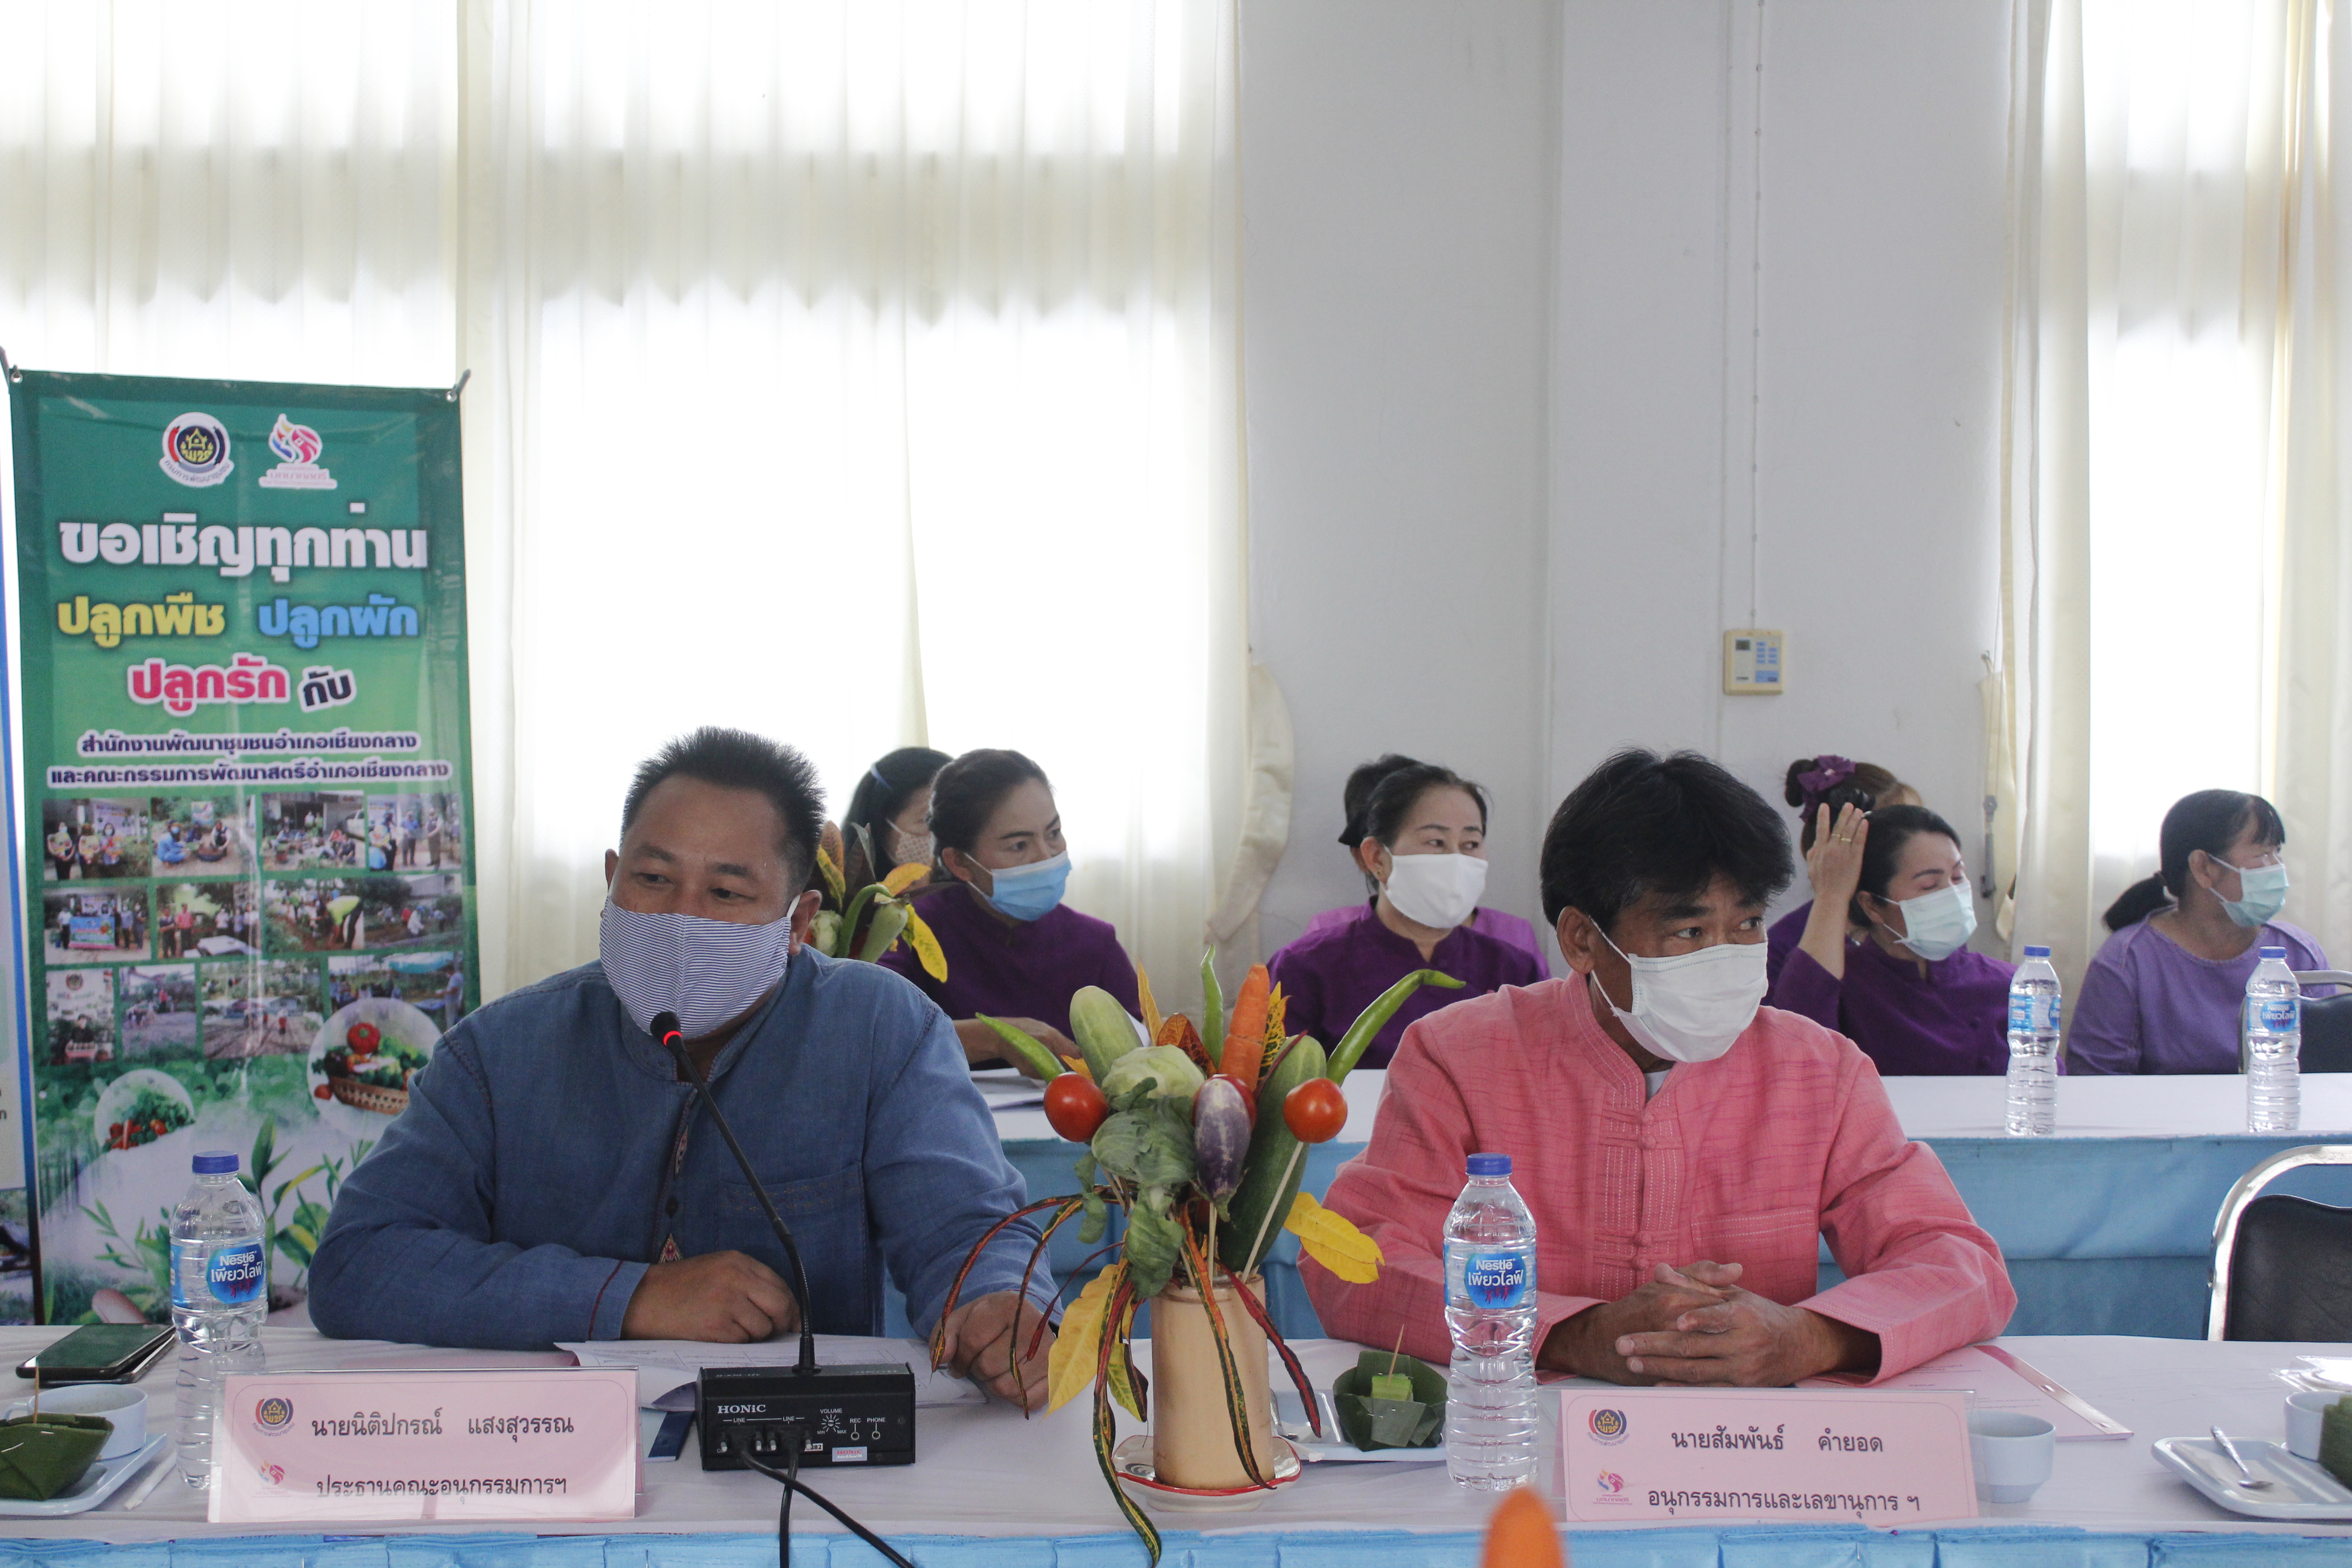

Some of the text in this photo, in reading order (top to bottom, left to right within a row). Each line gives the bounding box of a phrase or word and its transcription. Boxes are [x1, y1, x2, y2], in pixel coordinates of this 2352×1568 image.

[59, 503, 428, 582] ขอเชิญทุกท่าน
[58, 593, 419, 648] ปลูกพืช ปลูกผัก
[132, 658, 352, 711] ปลูกรัก กับ
[83, 731, 417, 755] สำนักงานพัฒนาชุมชนอำเภอเชียงกลาง
[52, 760, 449, 783] และคณะกรรมการพัฒนาสตรีอำเภอเชียงกลาง
[211, 1260, 263, 1283] เพียวไลฟ์
[220, 1251, 255, 1266] Nestlé
[1475, 1258, 1513, 1270] Nestlé
[1468, 1269, 1524, 1286] เพียวไลฟ์
[311, 1407, 574, 1443] นายนิติปกรณ์ แสงสุวรรณ
[1671, 1423, 1883, 1452] นายสัมพันธ์ คำยอด
[316, 1474, 567, 1505] ประธานคณะอนุกรรมการฯ
[1648, 1490, 1920, 1519] อนุกรรมการและเลขานุการ ฯ
